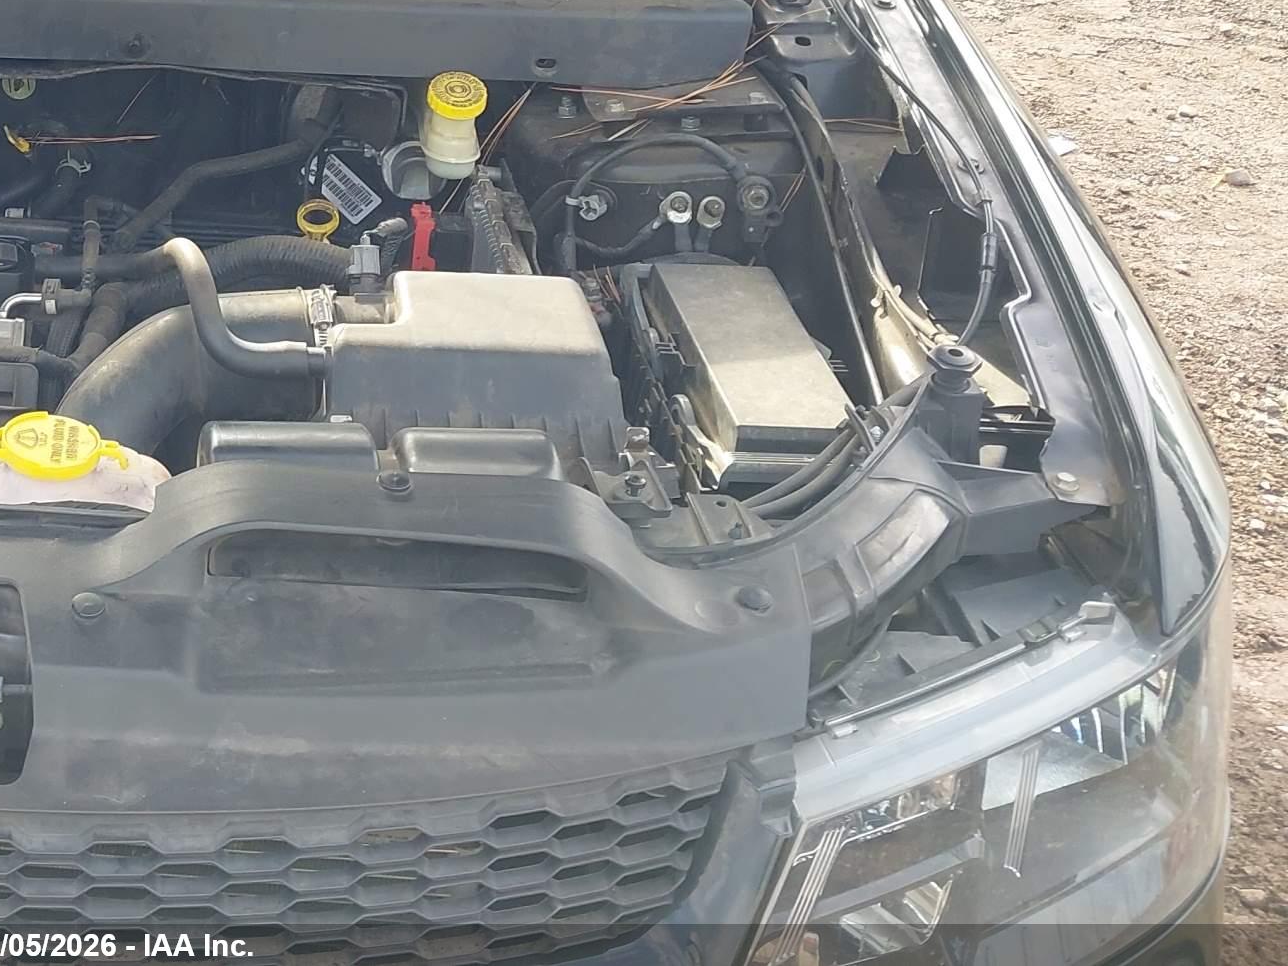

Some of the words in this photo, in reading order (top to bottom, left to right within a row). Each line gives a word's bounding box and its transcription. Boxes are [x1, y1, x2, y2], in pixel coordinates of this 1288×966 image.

[53, 419, 66, 441] FLUID
[50, 442, 63, 463] ONLY
[66, 426, 79, 460] WASHER
